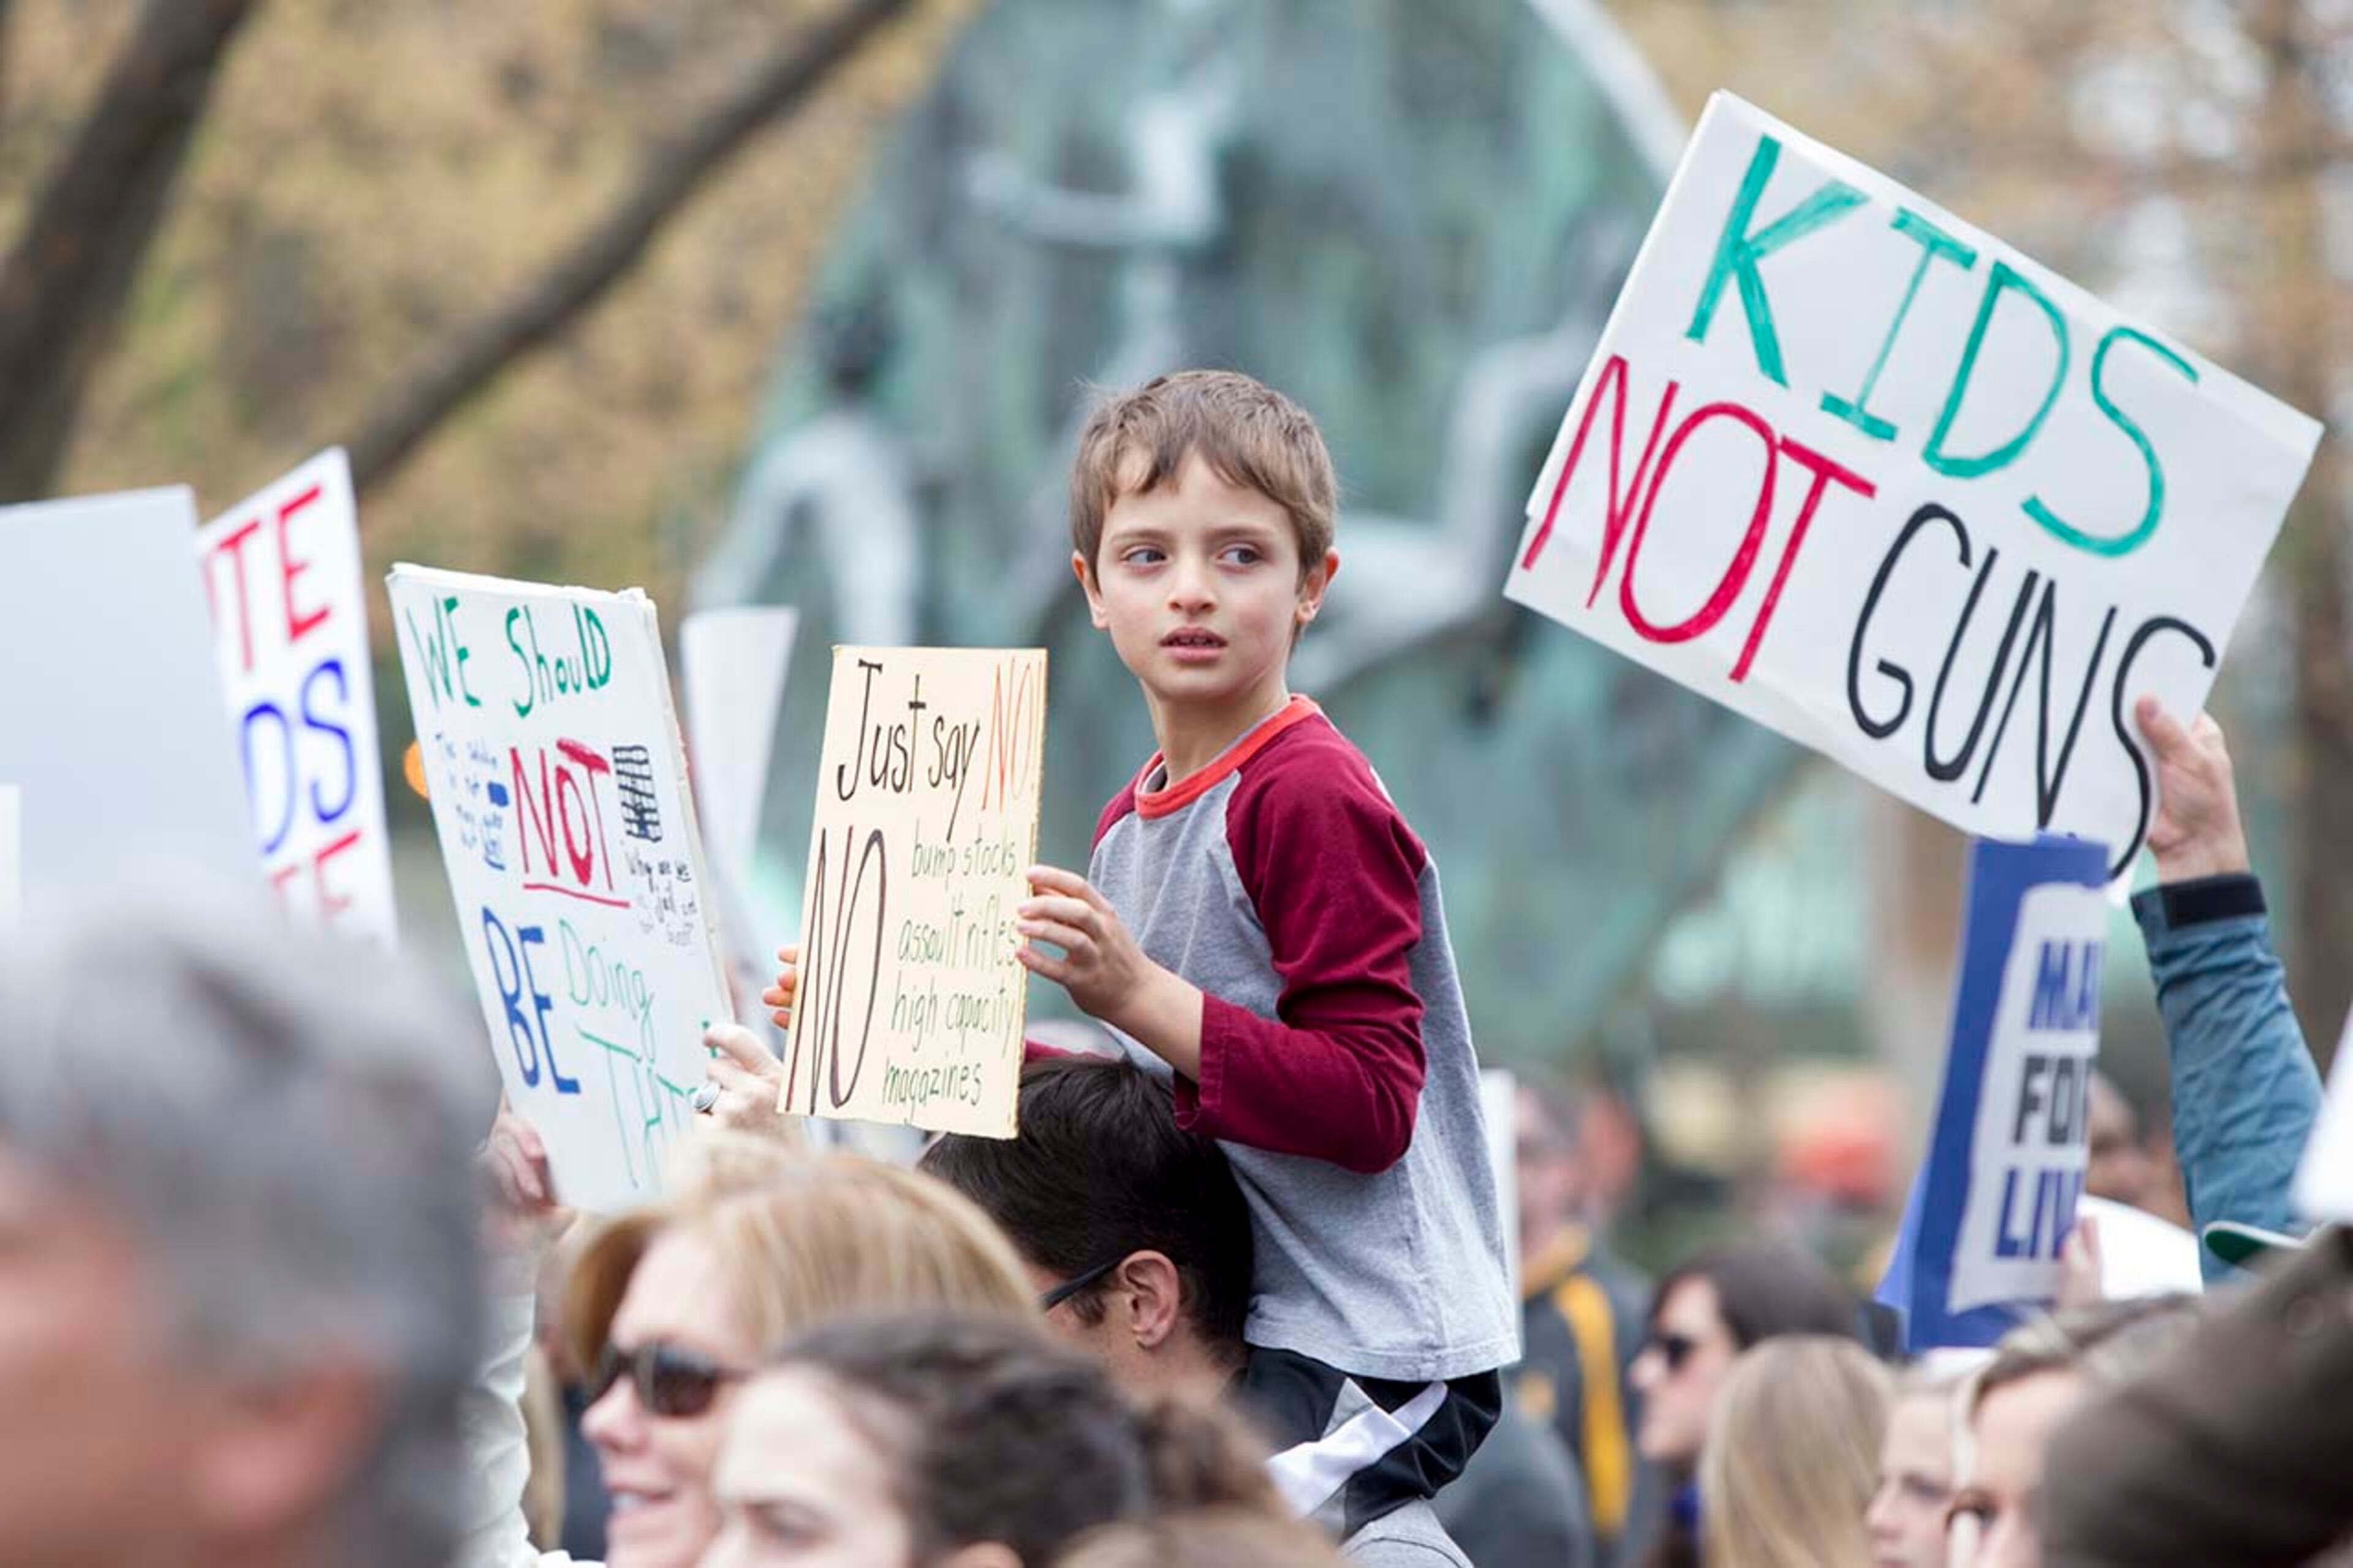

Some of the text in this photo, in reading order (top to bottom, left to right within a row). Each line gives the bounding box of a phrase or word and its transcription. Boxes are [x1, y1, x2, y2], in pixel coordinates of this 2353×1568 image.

[1684, 132, 2200, 559] KIDS
[1521, 353, 1877, 684] NOT
[406, 596, 484, 710] WE
[1846, 502, 2217, 882] GUNS
[509, 737, 613, 892] NOT
[836, 656, 1036, 844] Just say NO
[897, 888, 1018, 974] assault rifles
[912, 816, 1020, 892] bump stocks
[482, 906, 657, 1094] BE Doing
[785, 825, 889, 1116] NO
[890, 968, 1017, 1060] high capacity
[881, 1053, 984, 1126] magazines
